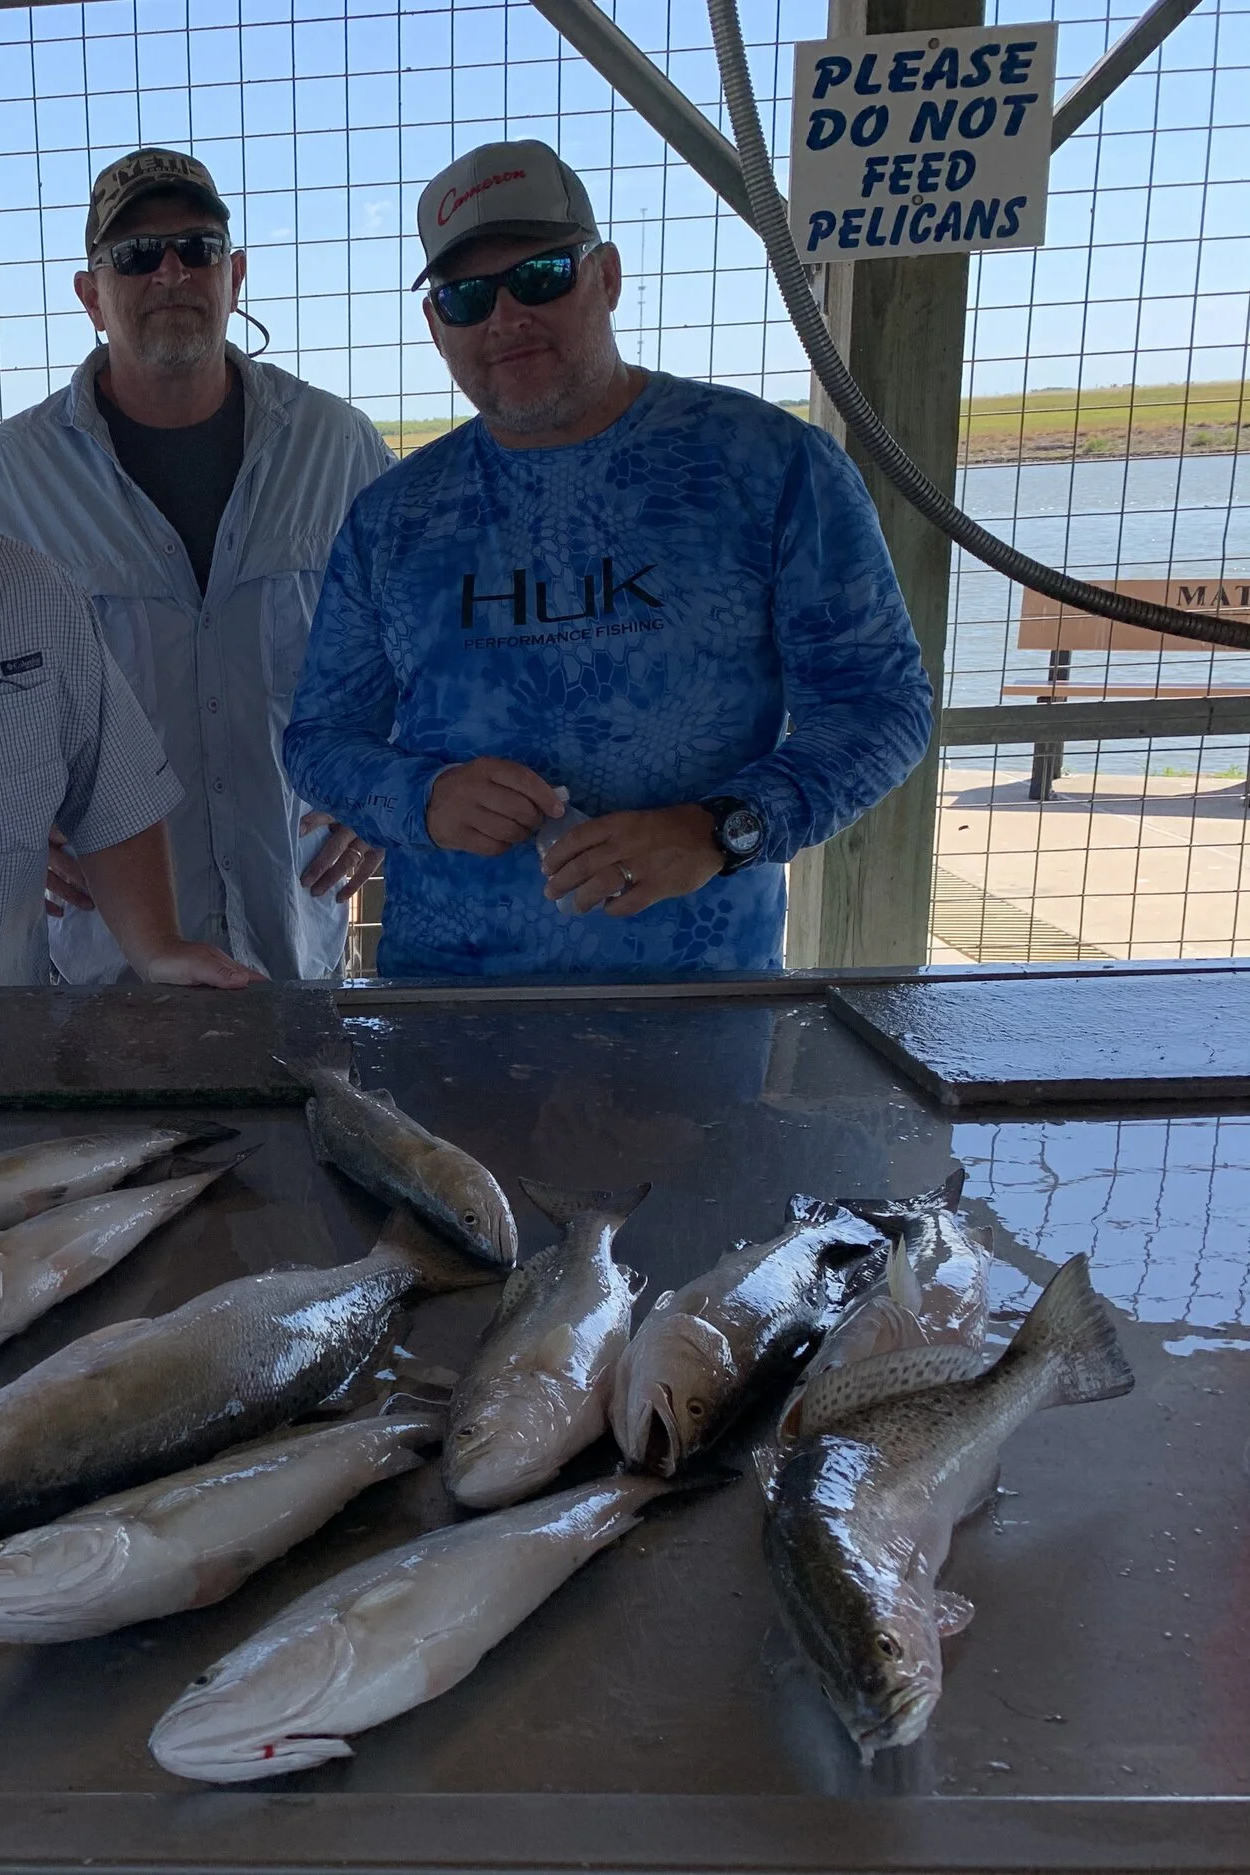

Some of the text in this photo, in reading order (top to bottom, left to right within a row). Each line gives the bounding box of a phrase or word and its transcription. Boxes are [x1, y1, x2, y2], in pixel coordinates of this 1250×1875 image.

[812, 41, 1038, 99] PLEASE
[806, 93, 1038, 151] DO NOT
[437, 168, 527, 226] Cameron
[861, 149, 977, 198] FEED
[806, 195, 1028, 251] PELICANS
[464, 617, 666, 650] PERFORMANCE FISHING
